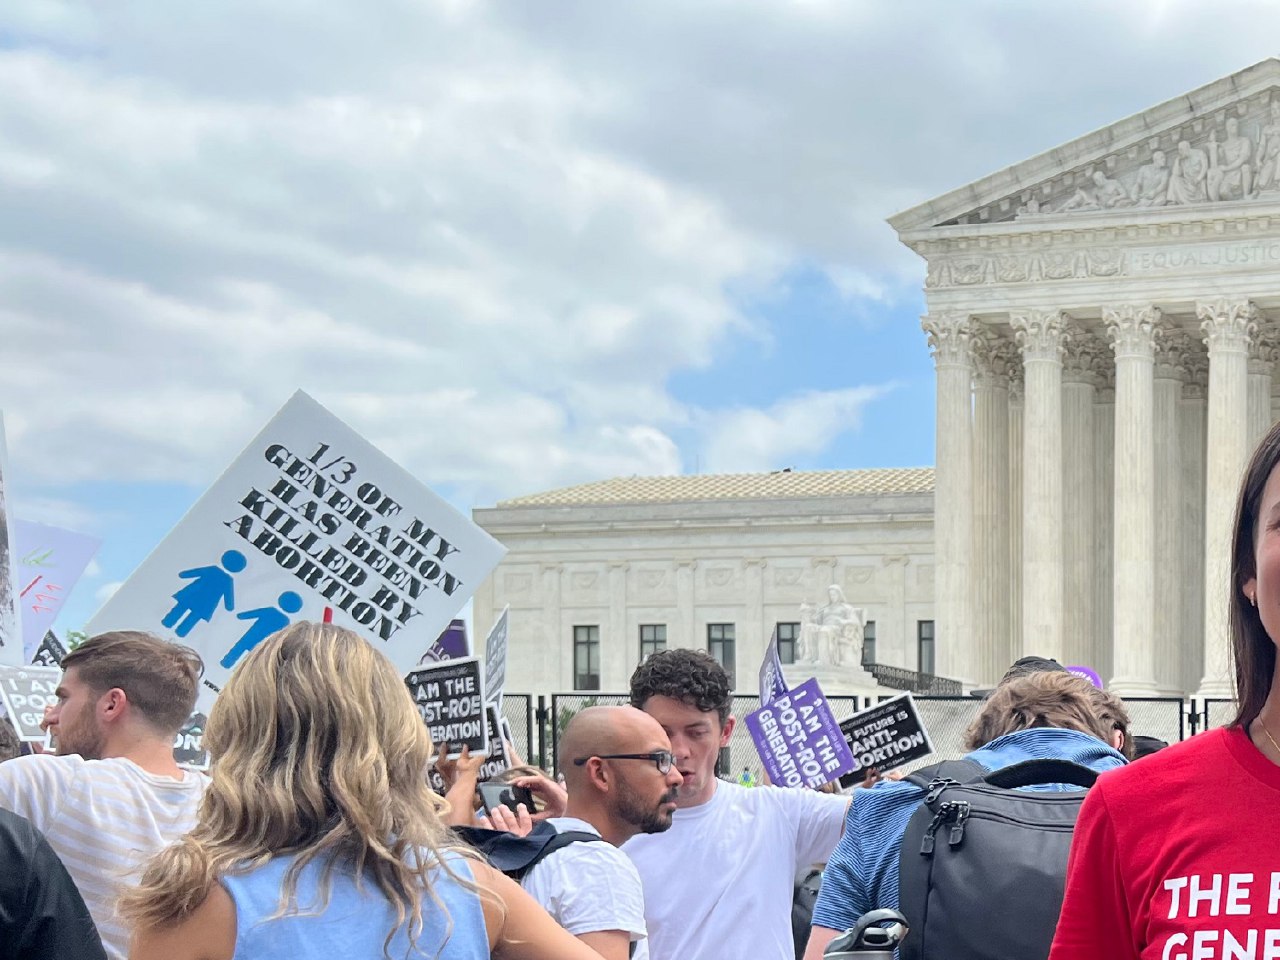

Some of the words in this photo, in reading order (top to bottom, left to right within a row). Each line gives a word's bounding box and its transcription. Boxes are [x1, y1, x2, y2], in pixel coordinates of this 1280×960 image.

[1141, 252, 1208, 269] EQUAL
[264, 444, 464, 597] GENERATION
[306, 442, 357, 484] 1/3
[357, 482, 403, 518] OF
[403, 517, 461, 562] MY
[238, 487, 368, 587] KILLED
[370, 585, 424, 626] BY
[268, 476, 342, 535] HAS
[342, 531, 429, 600] BEEN
[223, 514, 408, 642] ABORTION
[416, 682, 440, 701] AM
[445, 676, 475, 696] THE
[794, 690, 807, 701] I
[800, 705, 822, 733] AM
[854, 715, 896, 739] FUTURE
[896, 710, 908, 721] IS
[774, 696, 828, 789] POST-ROE
[815, 735, 841, 773] THE
[852, 729, 898, 756] ANTI-
[1164, 872, 1254, 919] THE
